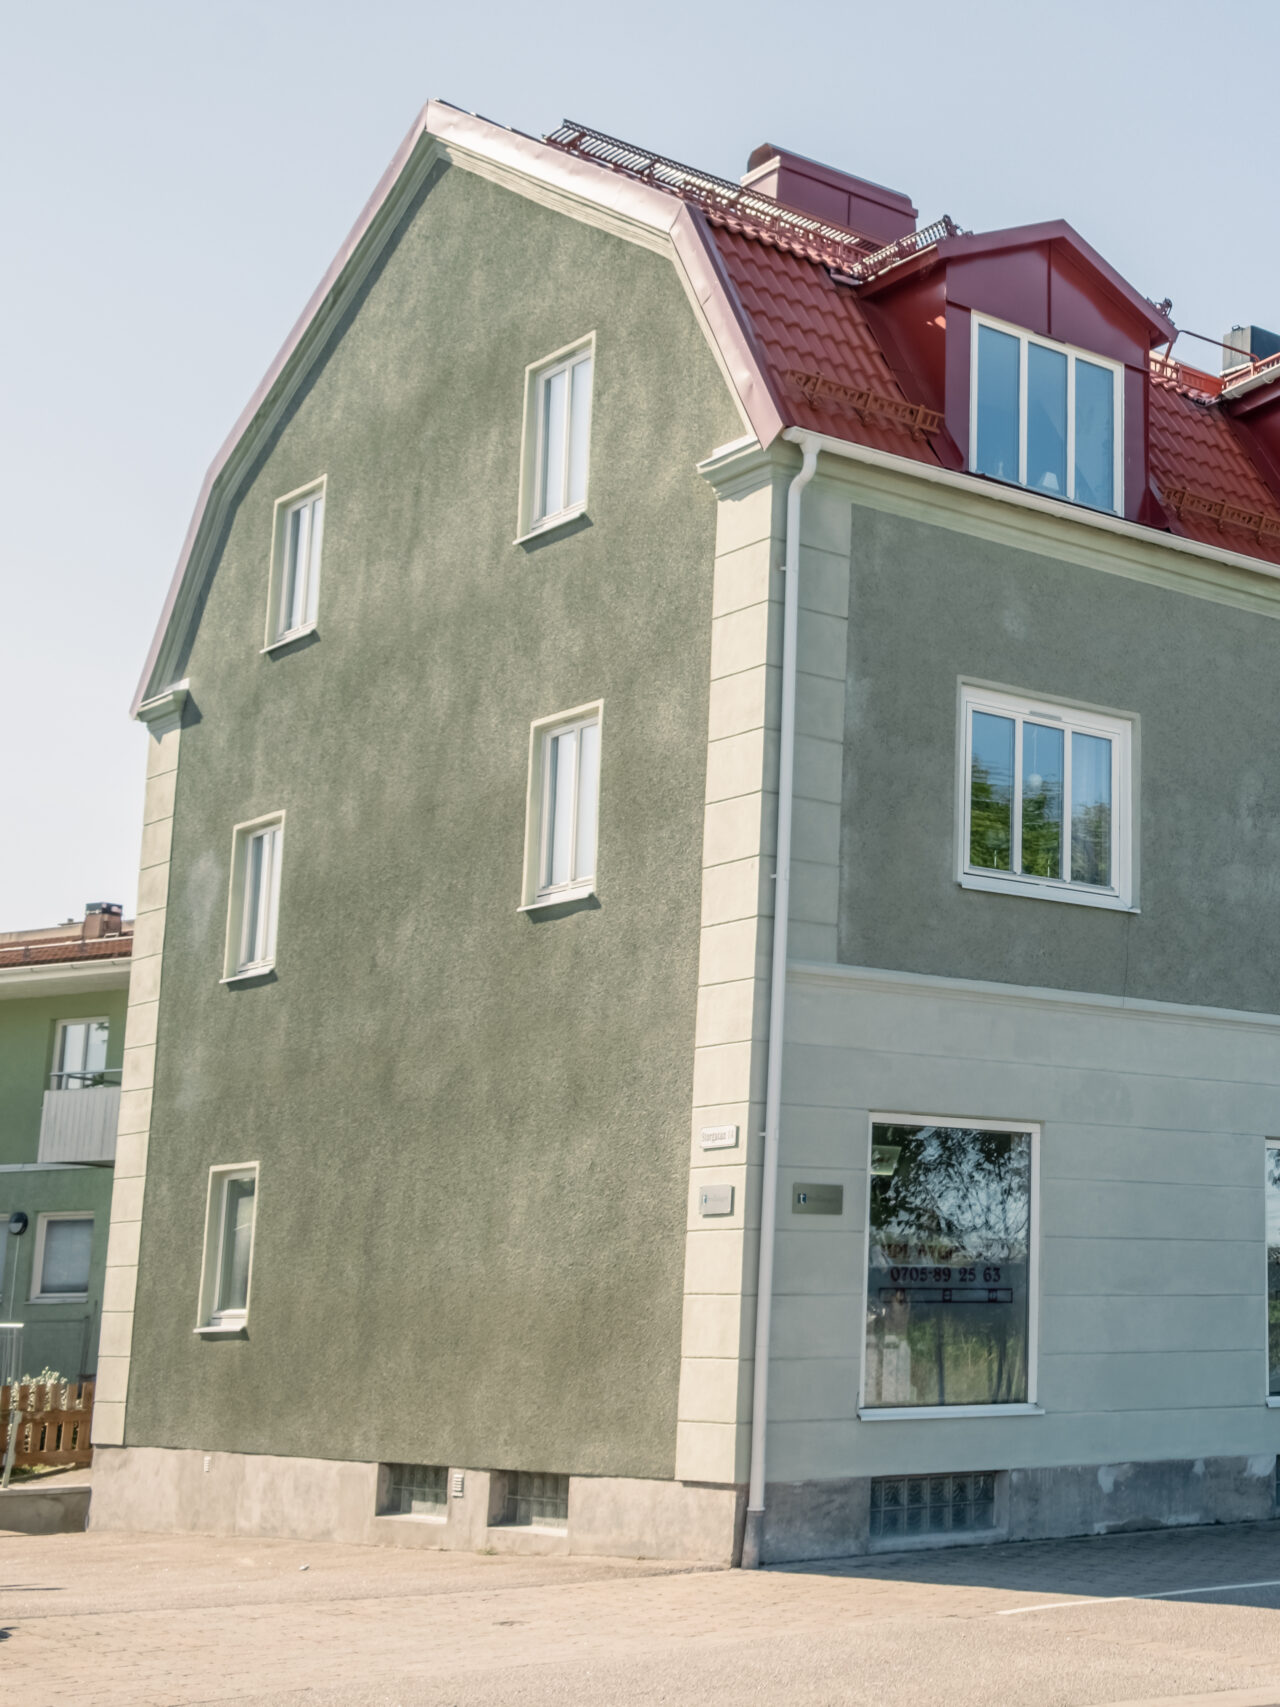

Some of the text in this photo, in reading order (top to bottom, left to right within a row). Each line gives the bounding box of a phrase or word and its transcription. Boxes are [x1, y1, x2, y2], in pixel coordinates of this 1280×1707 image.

[889, 1266, 1001, 1282] 0705-89 25 63
